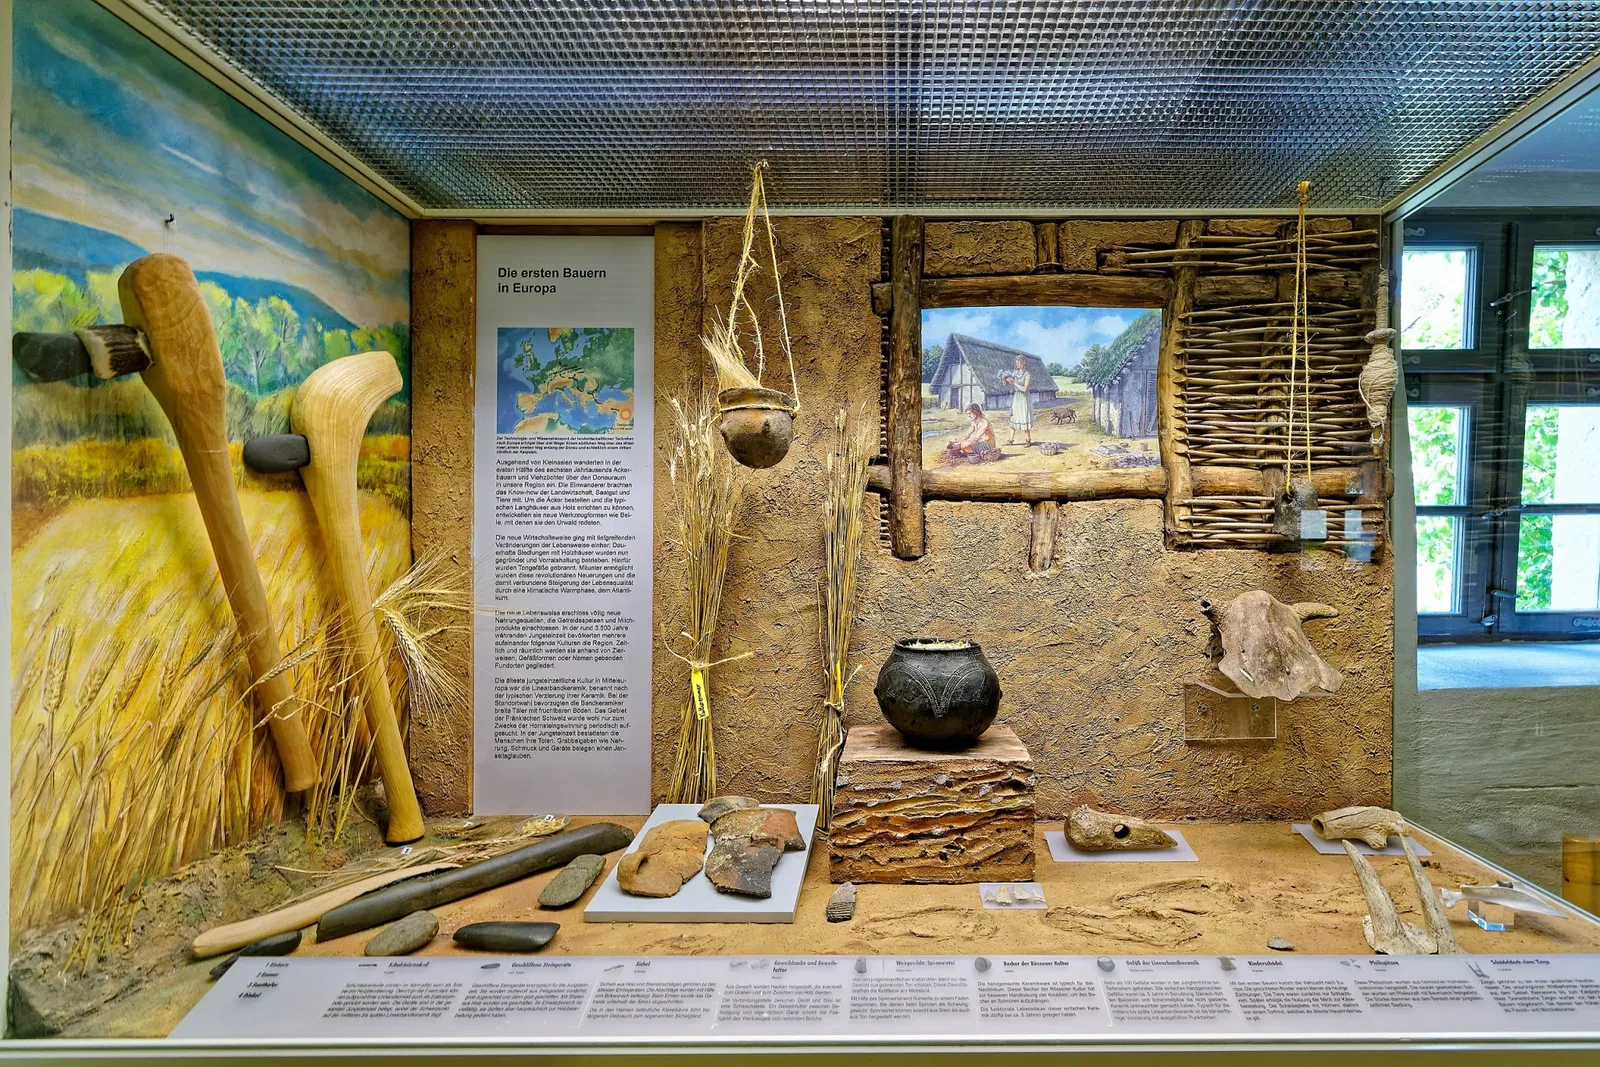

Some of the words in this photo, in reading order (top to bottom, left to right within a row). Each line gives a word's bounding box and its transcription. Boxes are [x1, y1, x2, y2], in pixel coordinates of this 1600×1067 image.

[498, 268, 517, 277] Die
[521, 268, 559, 277] ersten
[563, 268, 606, 277] Bauern
[498, 283, 508, 292] in
[513, 283, 556, 295] Europa
